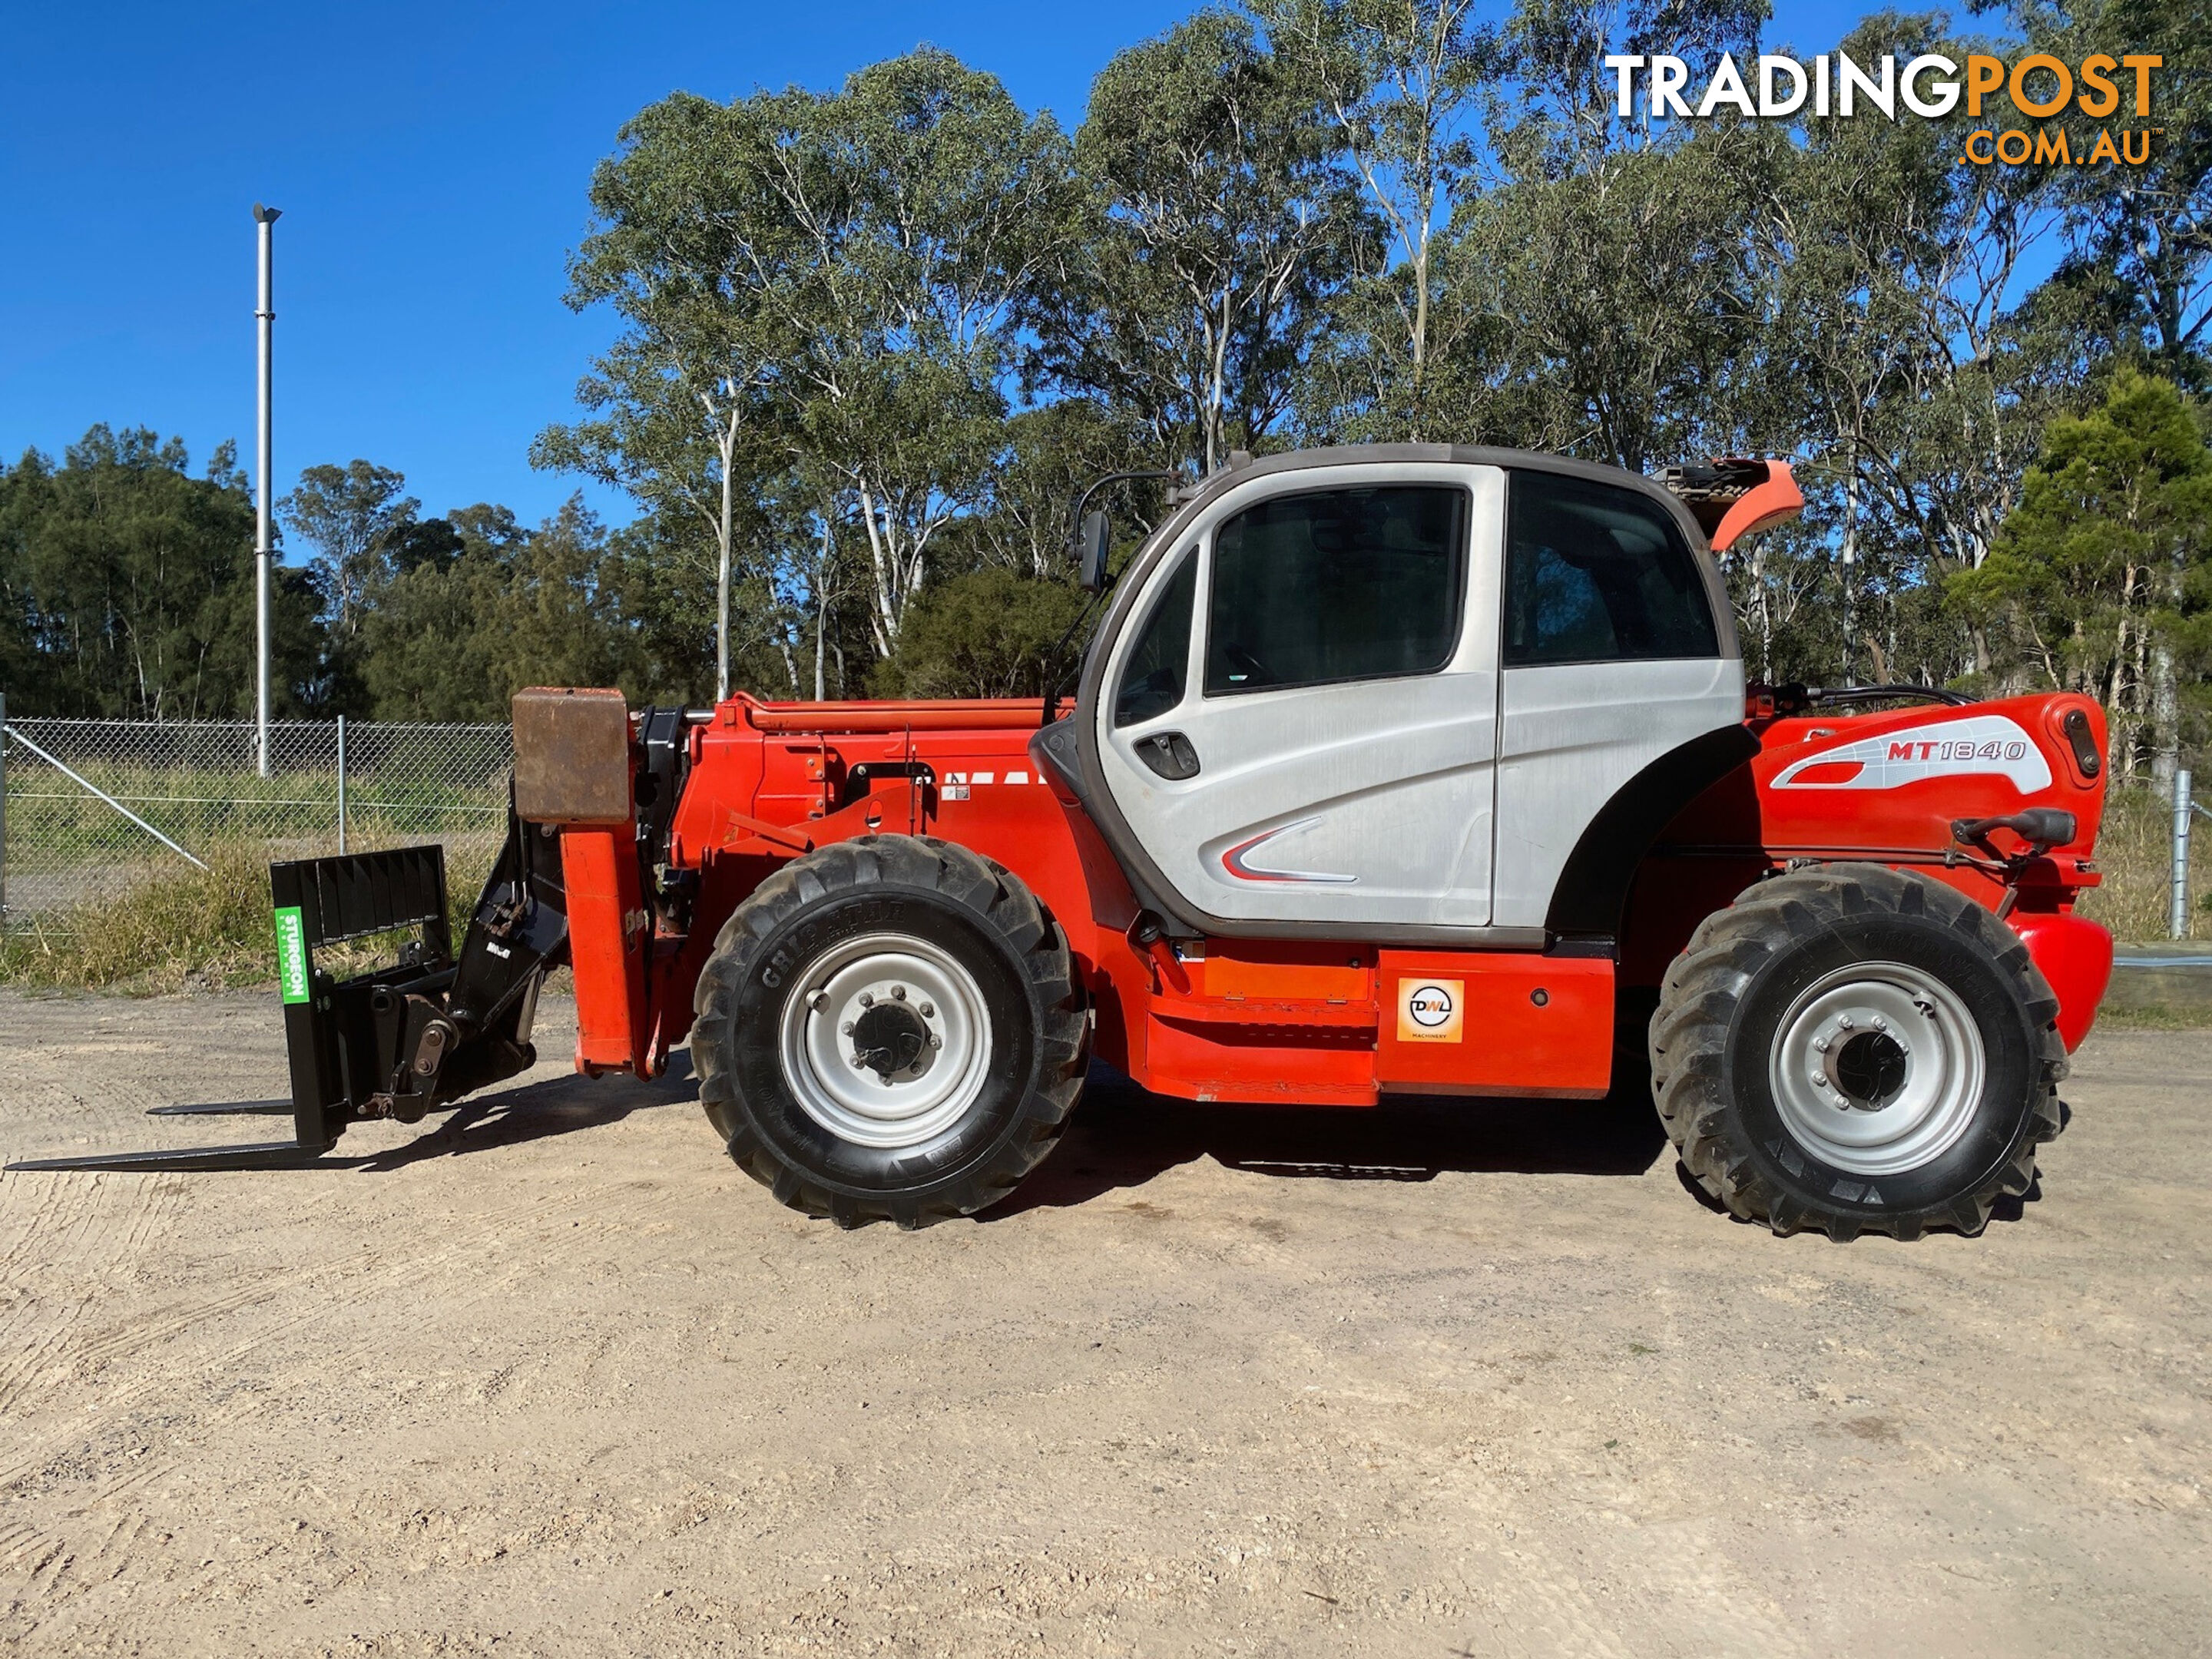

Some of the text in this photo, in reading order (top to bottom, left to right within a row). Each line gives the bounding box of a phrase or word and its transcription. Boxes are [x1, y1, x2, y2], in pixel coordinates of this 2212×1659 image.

[1888, 740, 2025, 760] MT1840
[286, 915, 304, 995] STURGEON
[1412, 1001, 1451, 1012] DWL
